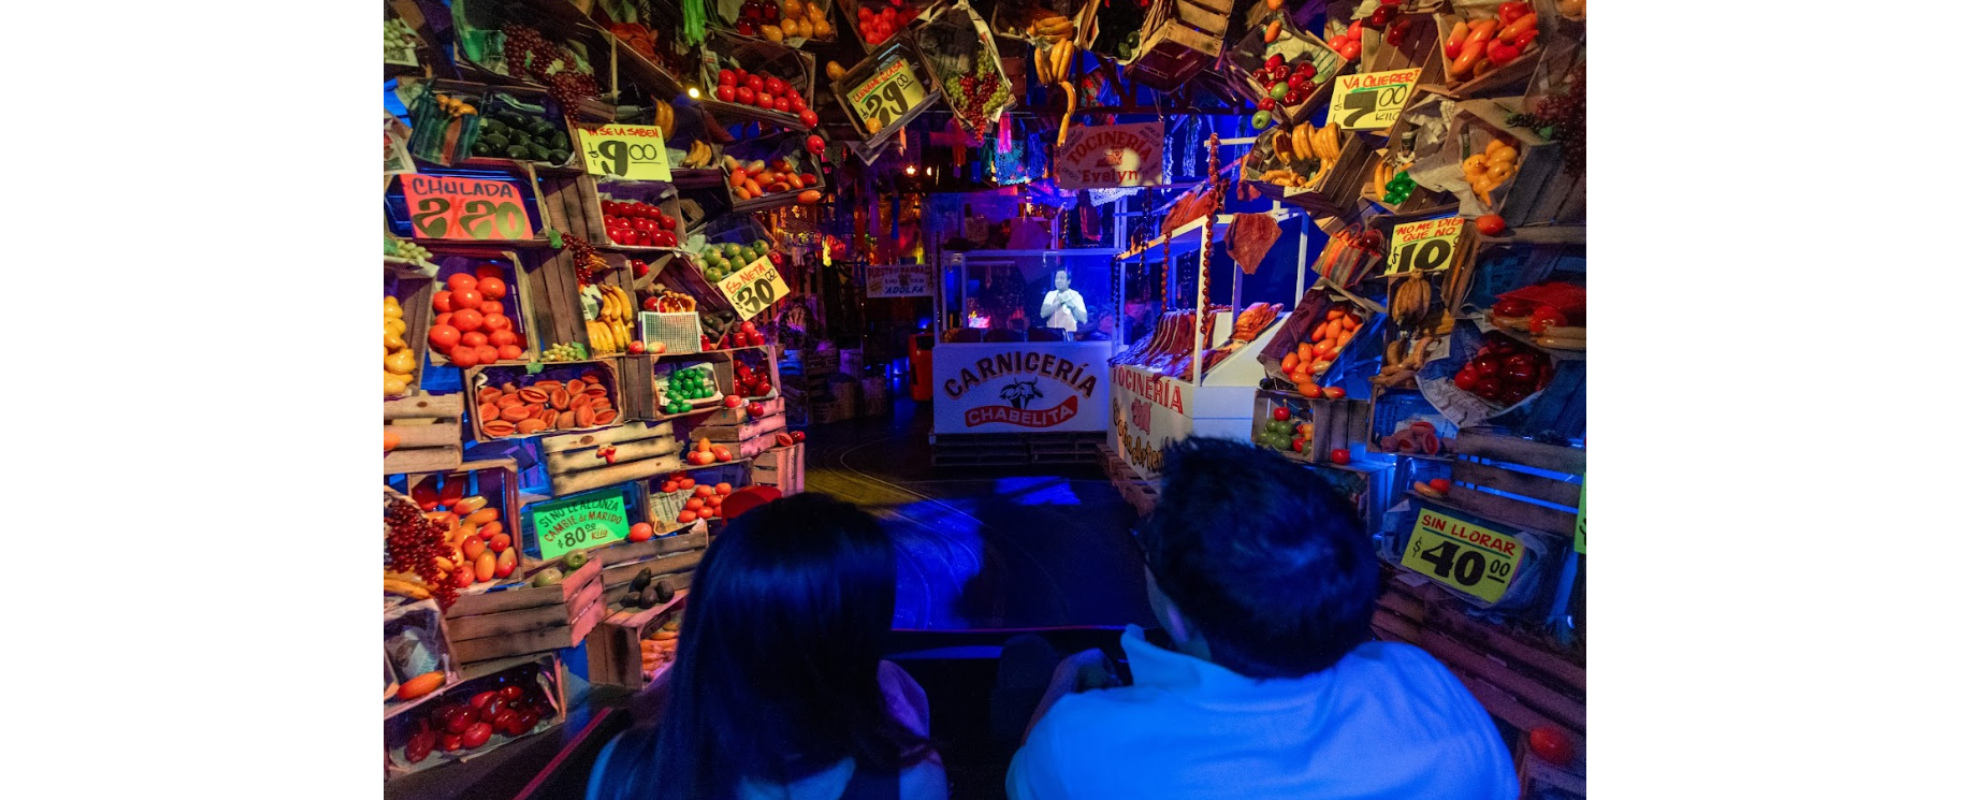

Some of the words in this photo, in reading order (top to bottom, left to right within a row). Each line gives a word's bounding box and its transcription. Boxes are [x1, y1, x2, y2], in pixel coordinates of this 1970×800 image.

[1343, 76, 1360, 90] VA
[599, 127, 614, 136] SE
[613, 128, 626, 137] LA
[626, 127, 660, 139] SABEN
[412, 178, 513, 199] CHULADA
[1402, 230, 1428, 243] QUE
[1434, 226, 1456, 237] NO
[1416, 221, 1435, 232] ME
[944, 350, 1098, 400] CARNICERÍA
[967, 405, 1075, 427] CHABELITA
[579, 499, 620, 512] ALCANZA
[544, 515, 578, 543] CAMBIE
[588, 511, 623, 526] MARIDO
[1421, 514, 1448, 532] SIN
[1450, 523, 1517, 557] LLORAR
